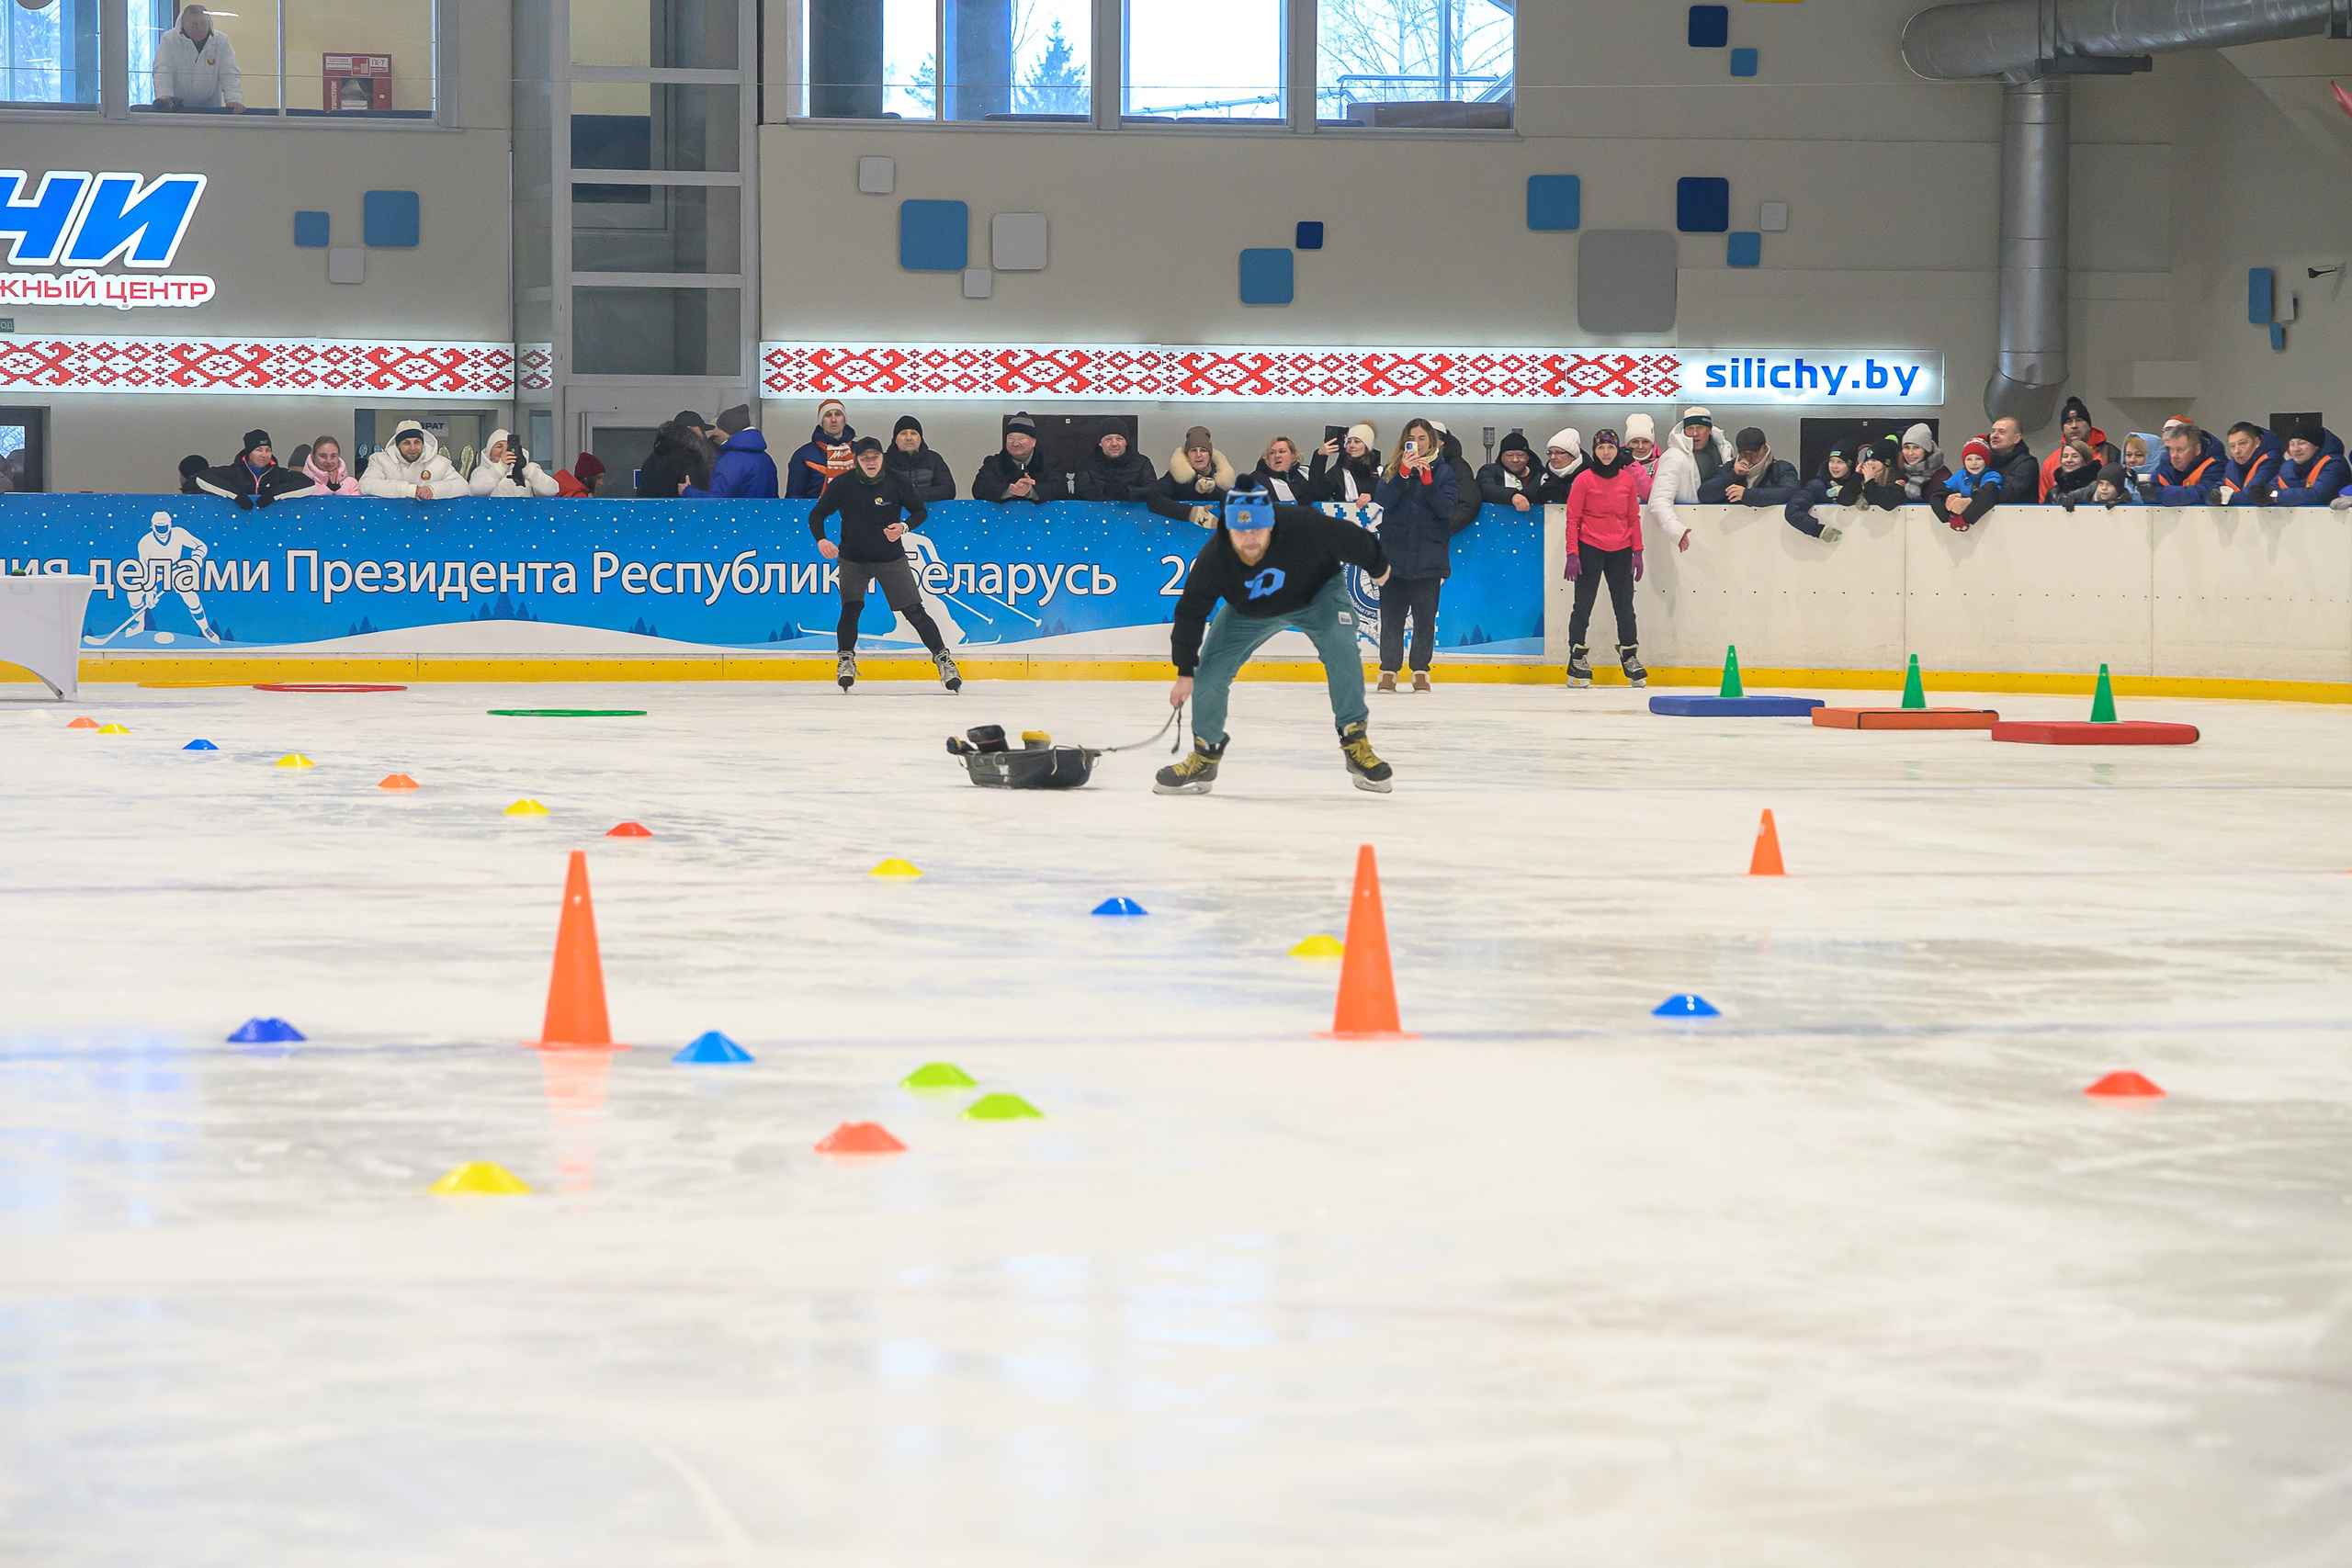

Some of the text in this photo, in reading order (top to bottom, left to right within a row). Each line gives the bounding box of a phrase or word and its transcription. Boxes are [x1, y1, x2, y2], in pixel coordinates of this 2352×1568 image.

[106, 281, 208, 303] ЦЕНТР
[1706, 357, 1920, 396] silichy.by
[89, 558, 270, 600] делами
[285, 549, 577, 604] Президента
[904, 551, 1118, 607] еларусь
